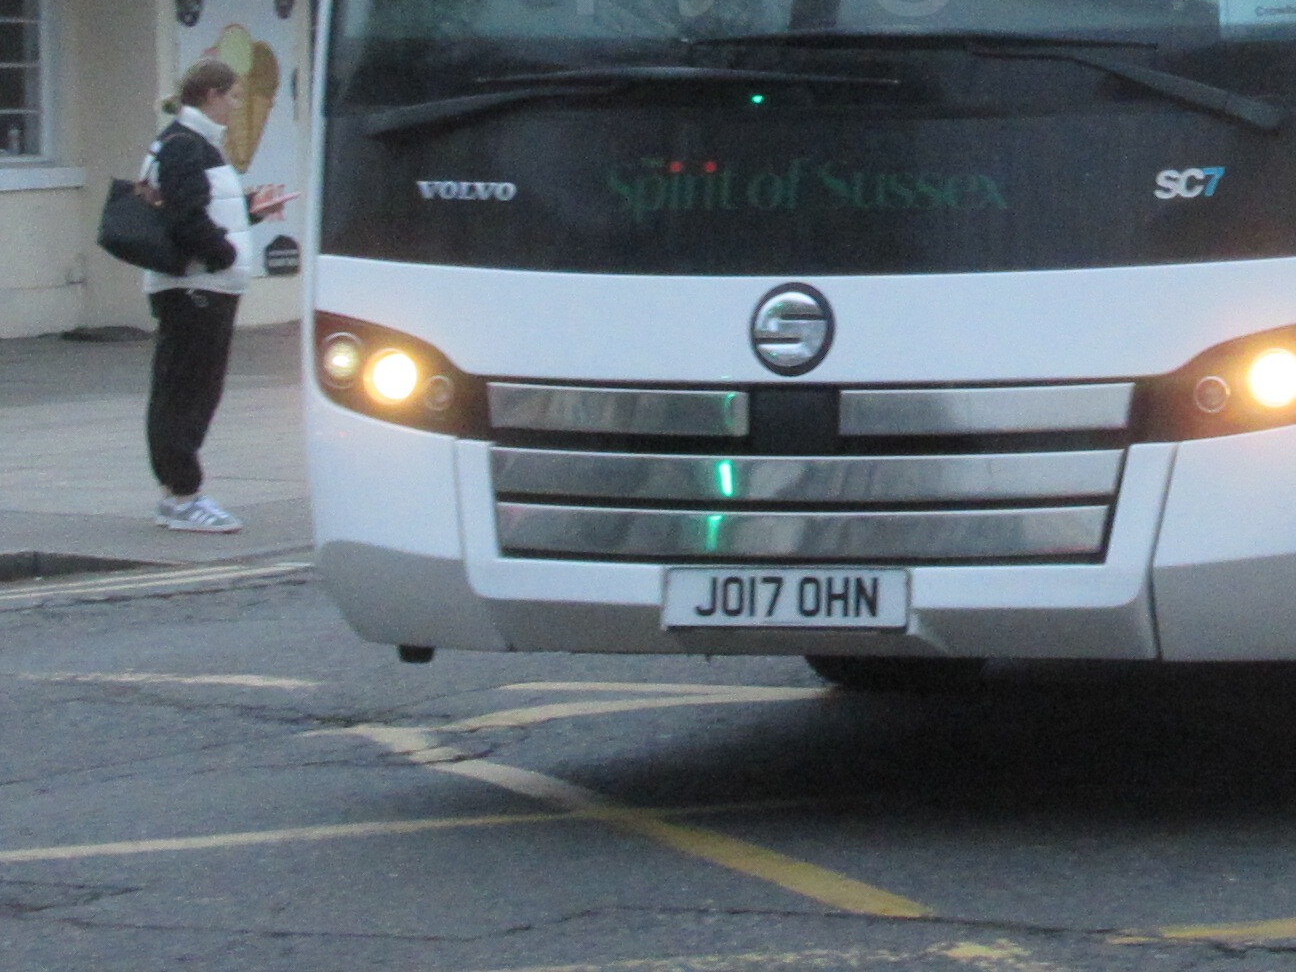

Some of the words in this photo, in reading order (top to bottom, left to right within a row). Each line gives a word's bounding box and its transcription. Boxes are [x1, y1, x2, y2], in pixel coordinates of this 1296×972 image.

[415, 180, 518, 201] VOLVO
[1154, 165, 1227, 200] SC7
[695, 576, 784, 618] JO17
[799, 576, 879, 618] OHN
